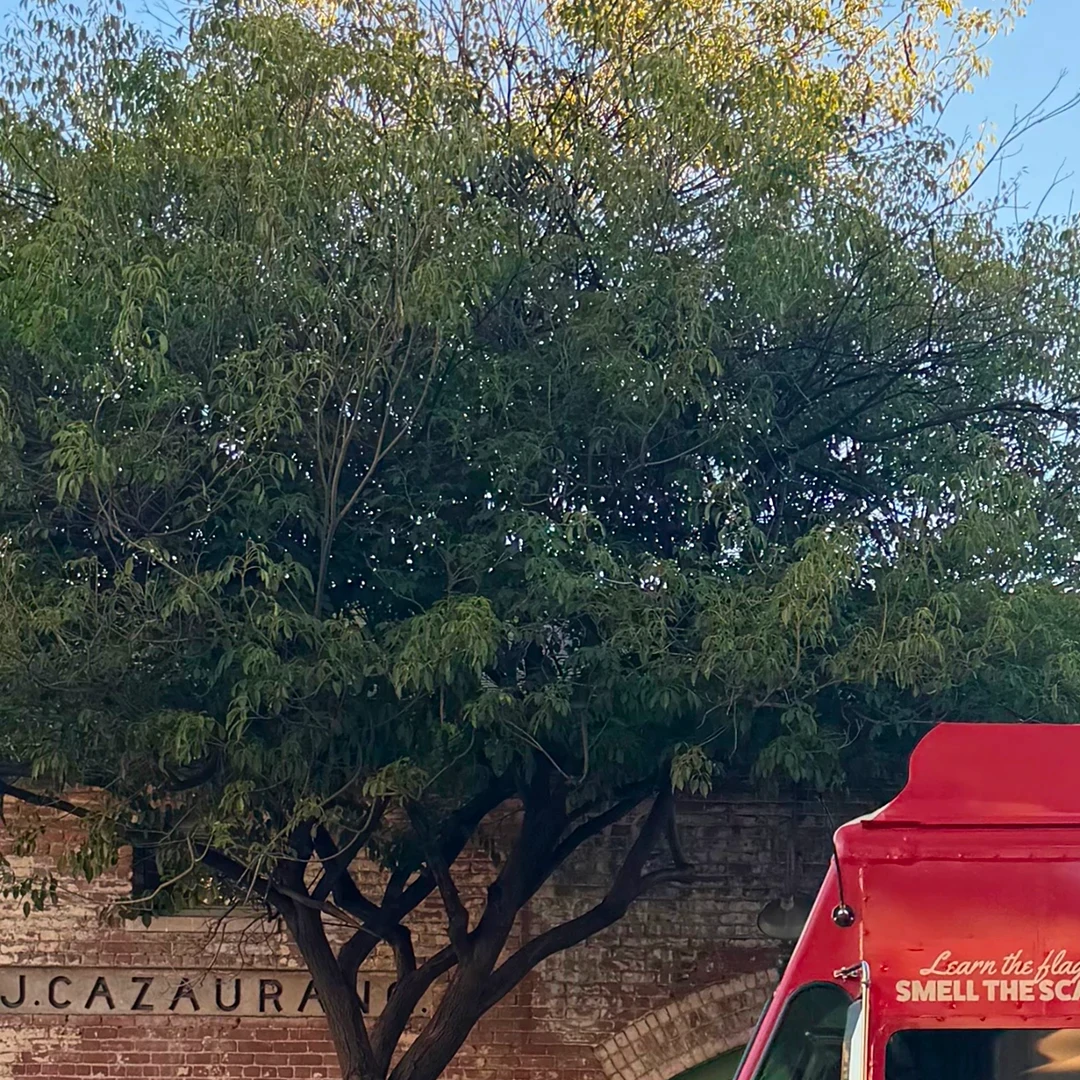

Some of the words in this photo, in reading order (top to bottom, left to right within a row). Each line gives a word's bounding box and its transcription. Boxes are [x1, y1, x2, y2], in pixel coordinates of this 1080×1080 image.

[919, 951, 997, 976] Learn
[1001, 949, 1033, 976] the
[896, 980, 979, 1002] SMELL
[982, 980, 1035, 1002] THE
